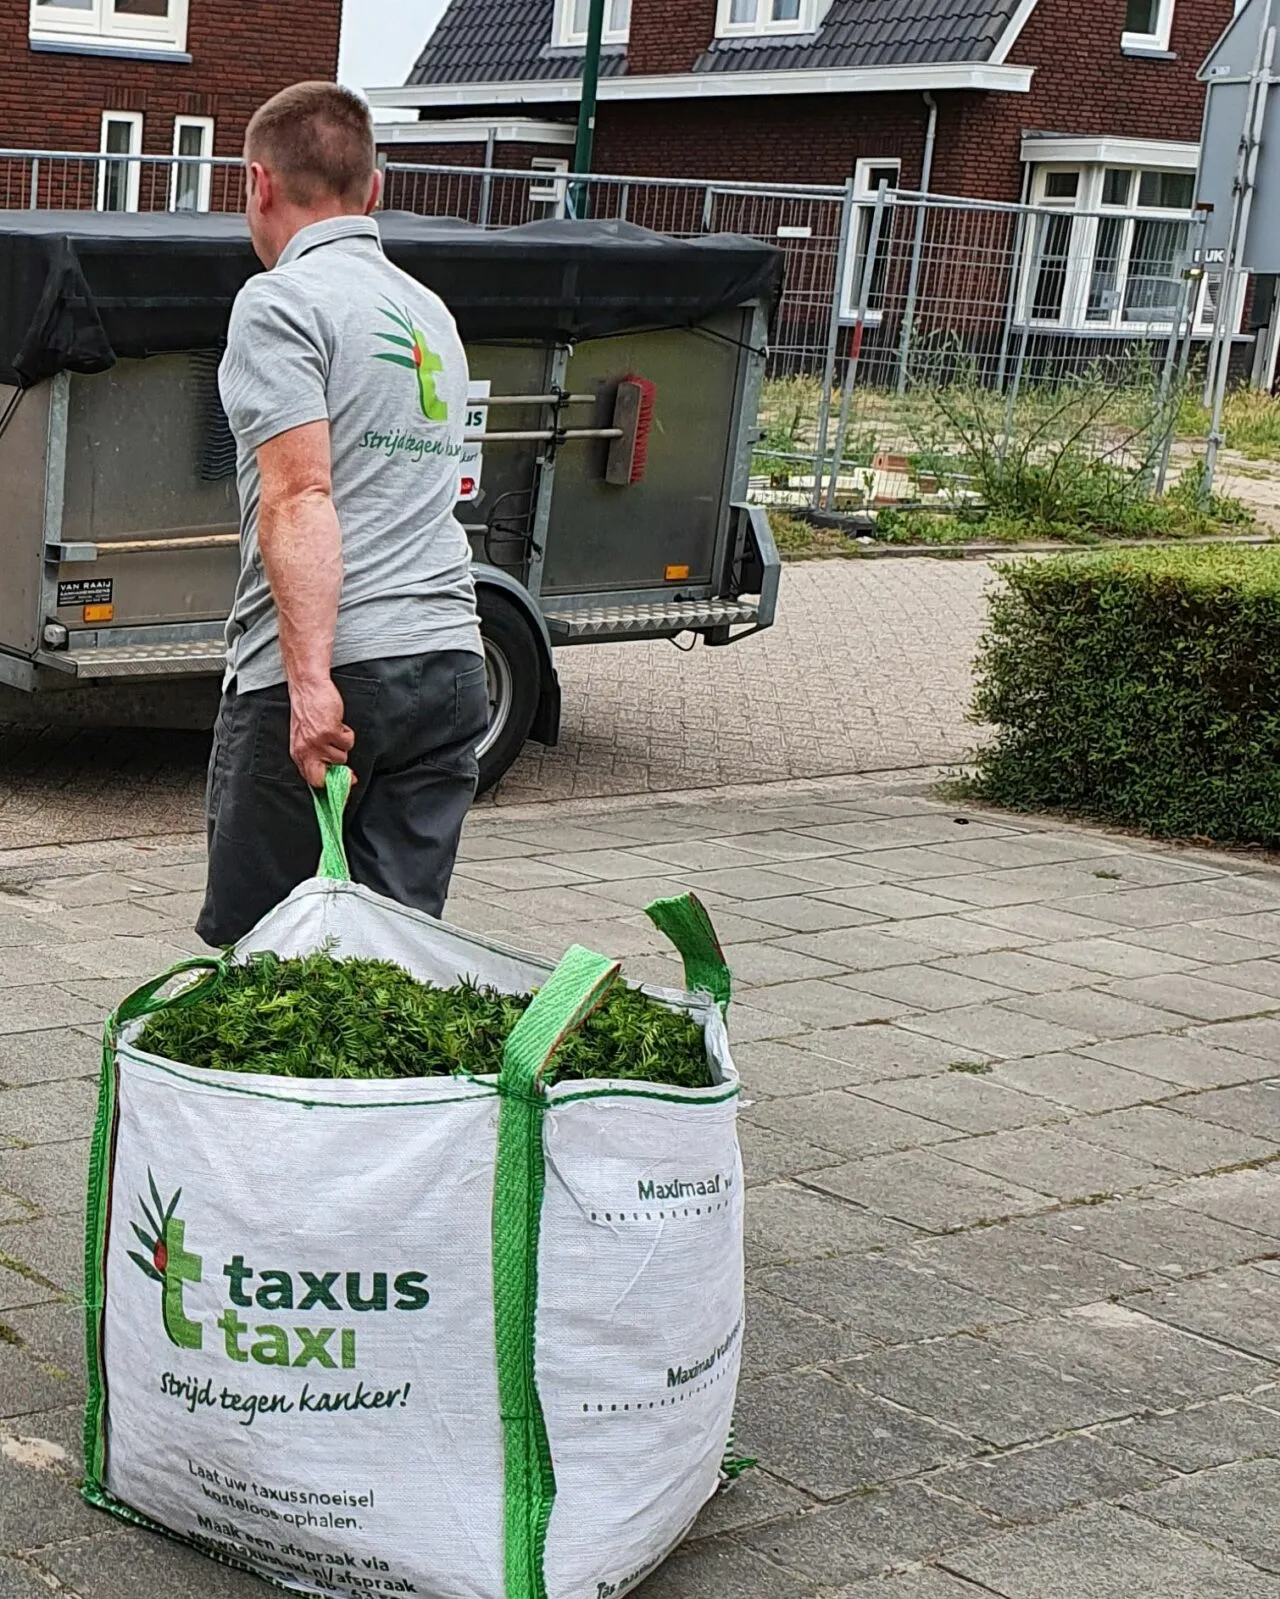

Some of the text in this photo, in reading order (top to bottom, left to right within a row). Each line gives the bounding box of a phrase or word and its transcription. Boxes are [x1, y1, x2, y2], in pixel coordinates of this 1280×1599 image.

[60, 581, 111, 591] VAN RAAIJ
[637, 1174, 721, 1201] Maximaal
[223, 1255, 430, 1311] taxus
[217, 1308, 356, 1369] taxi
[219, 1386, 293, 1426] tegen
[298, 1381, 411, 1412] kanker!
[188, 1458, 374, 1508] Laat uw taxussnoeisel
[201, 1483, 363, 1530] kosteloos ophalen.
[197, 1513, 389, 1572] Maak een afspraak via
